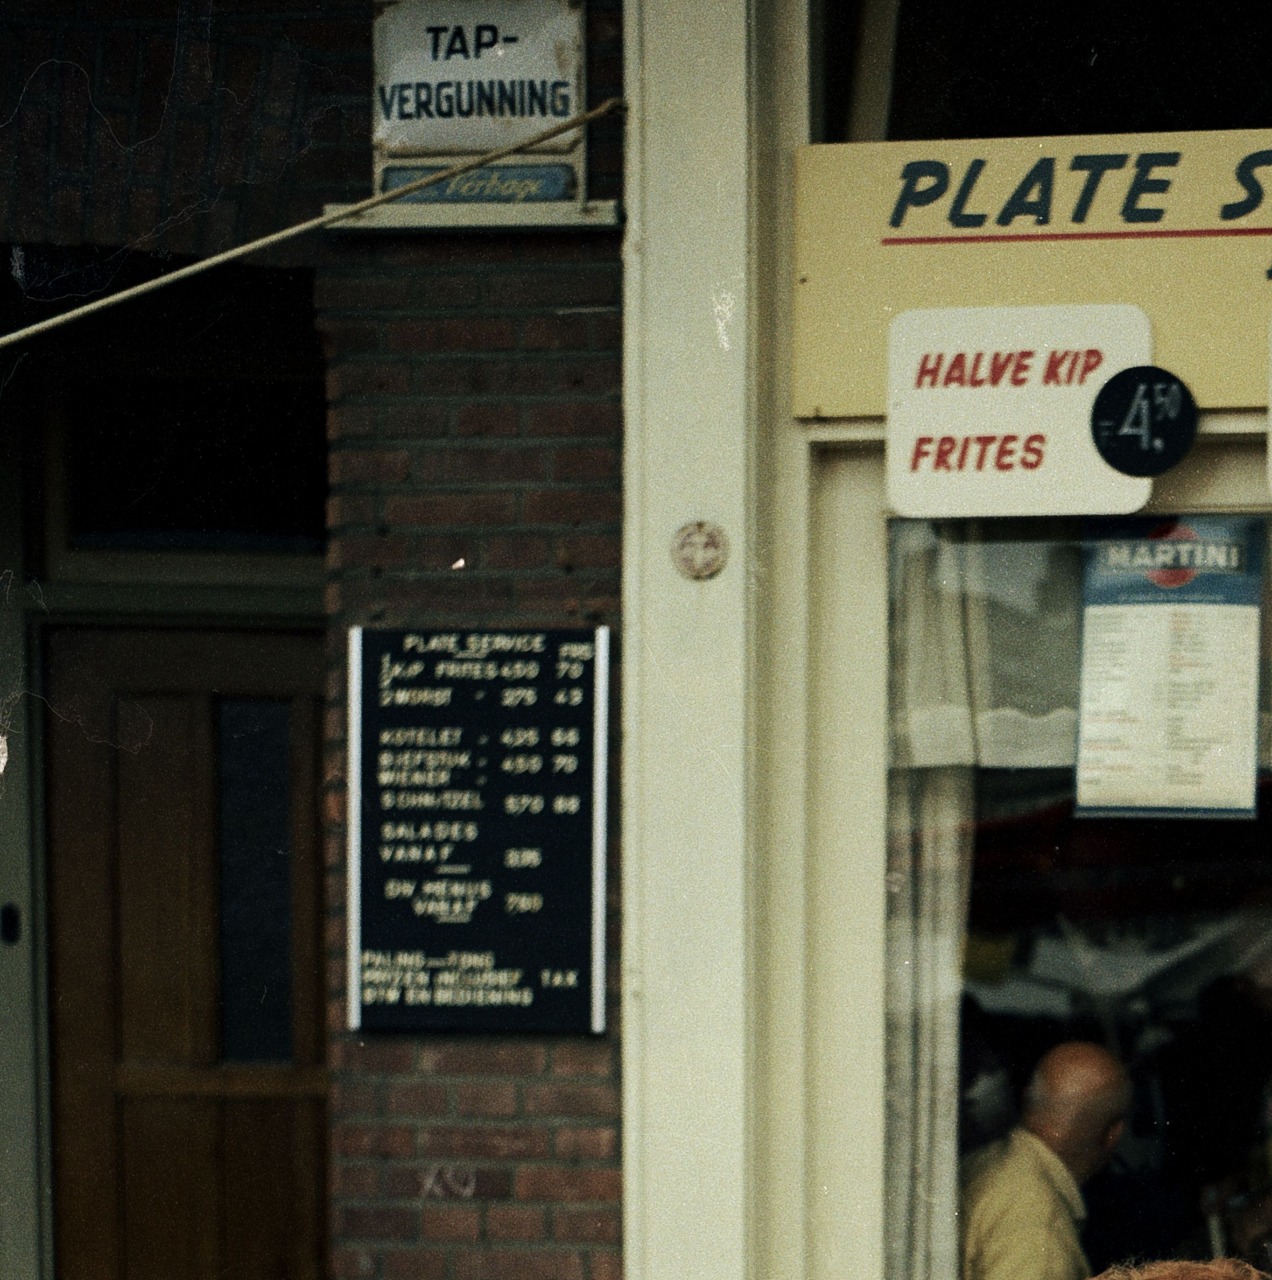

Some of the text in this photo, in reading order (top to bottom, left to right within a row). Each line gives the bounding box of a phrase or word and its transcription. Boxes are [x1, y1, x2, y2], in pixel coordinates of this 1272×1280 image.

[425, 23, 519, 61] TAP-
[379, 79, 571, 121] VERGUNNING
[889, 151, 1182, 228] PLATE
[915, 348, 1103, 389] HALVE KIP
[911, 433, 1047, 472] FRITES
[1106, 544, 1240, 569] MARTINI
[403, 633, 460, 653] PLATE
[466, 633, 546, 653] SERVICE
[379, 727, 463, 747] KOTELET
[380, 821, 479, 842] SALADES
[379, 843, 455, 863] VANAF
